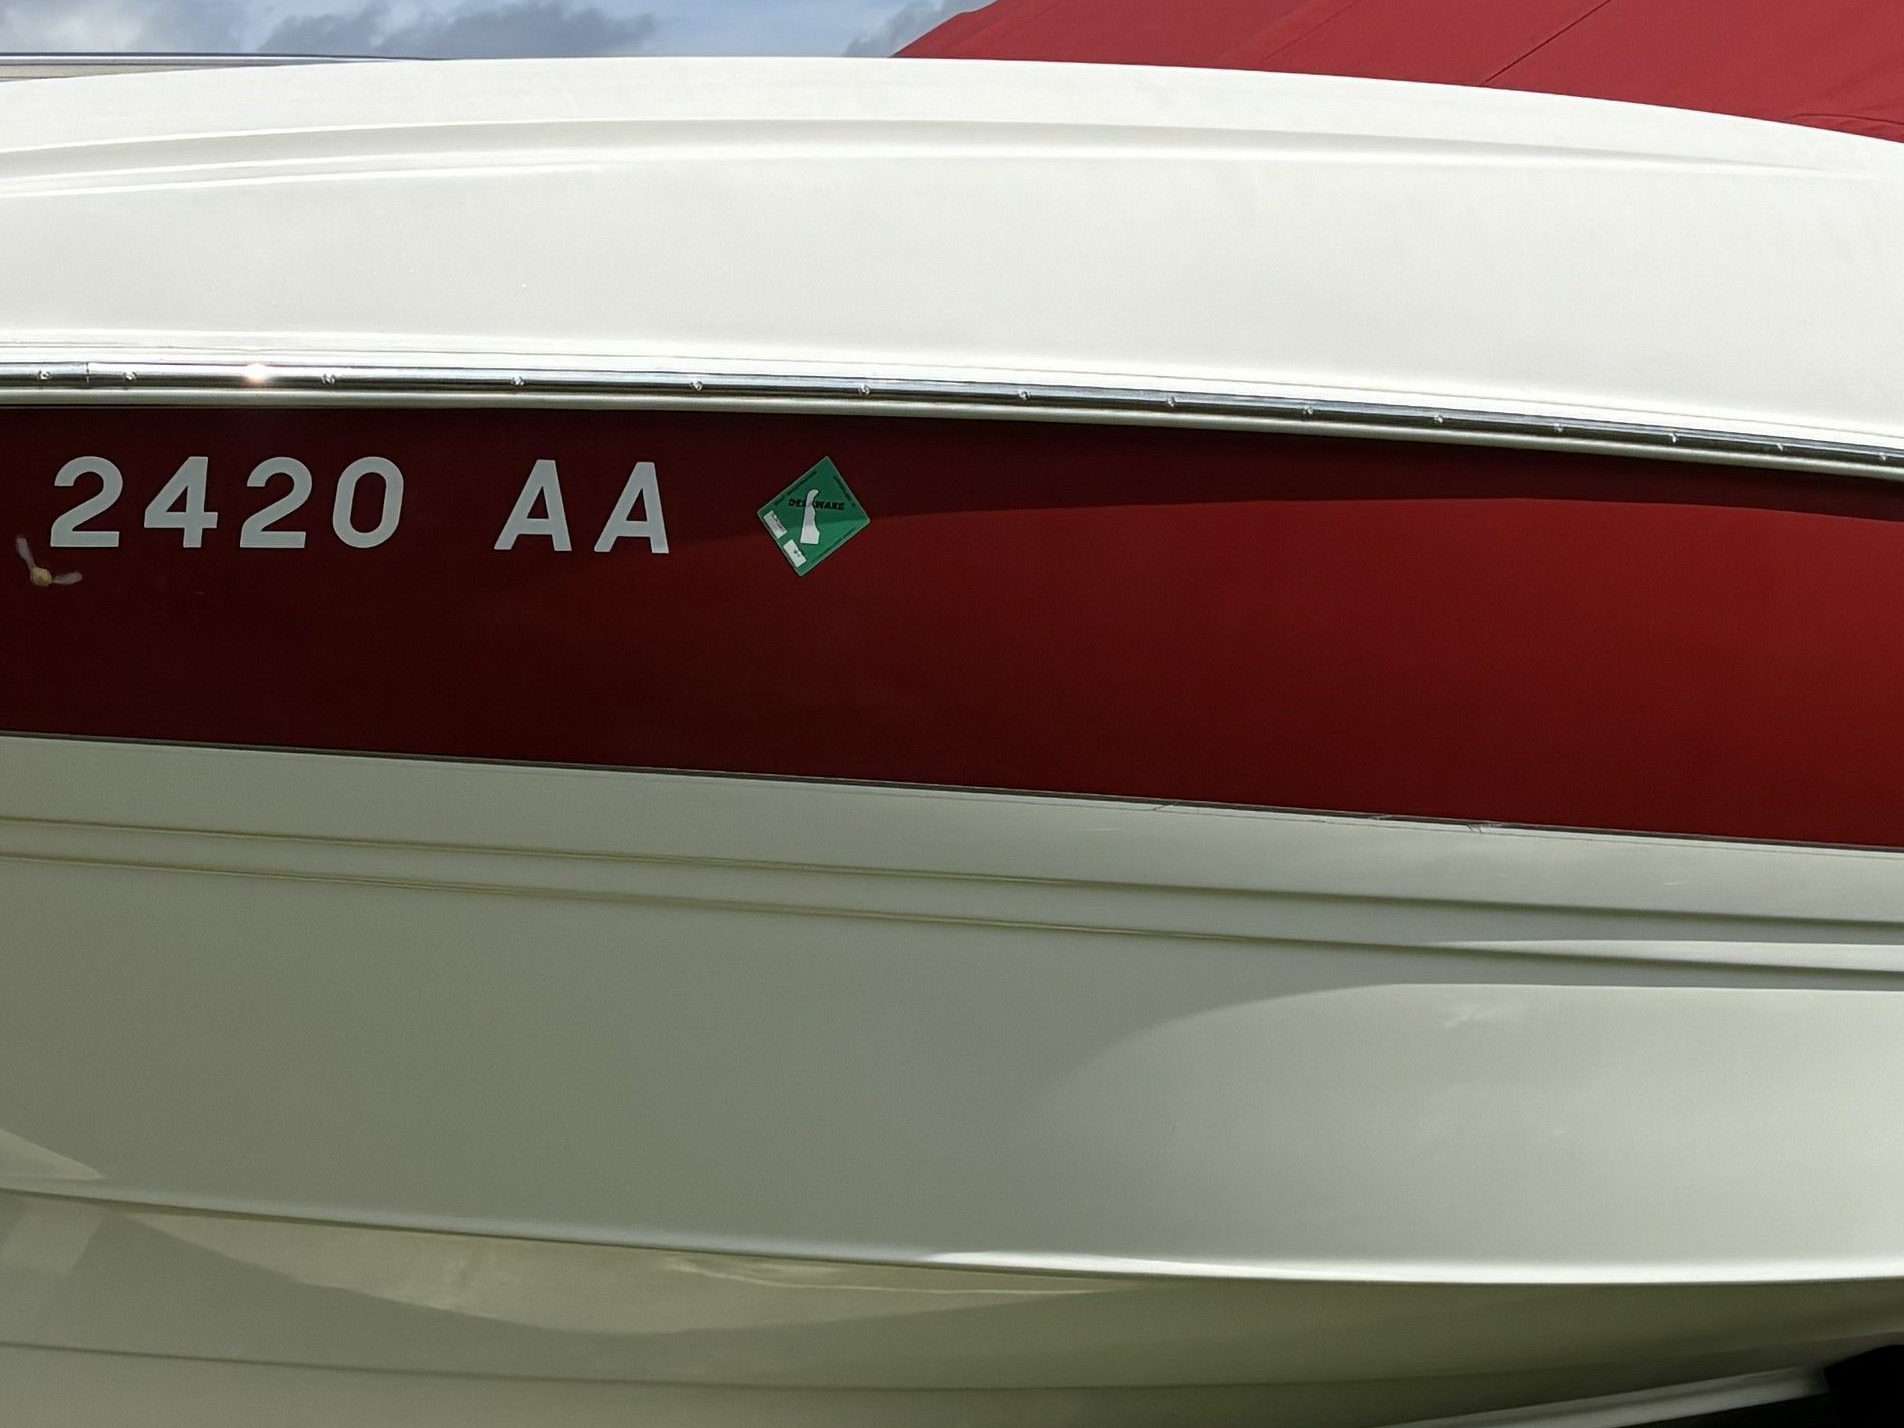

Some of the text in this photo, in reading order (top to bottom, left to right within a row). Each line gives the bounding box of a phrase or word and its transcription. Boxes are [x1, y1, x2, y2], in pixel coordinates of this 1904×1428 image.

[49, 455, 405, 549] 2420
[494, 459, 670, 554] AA
[788, 498, 845, 511] DELWARE
